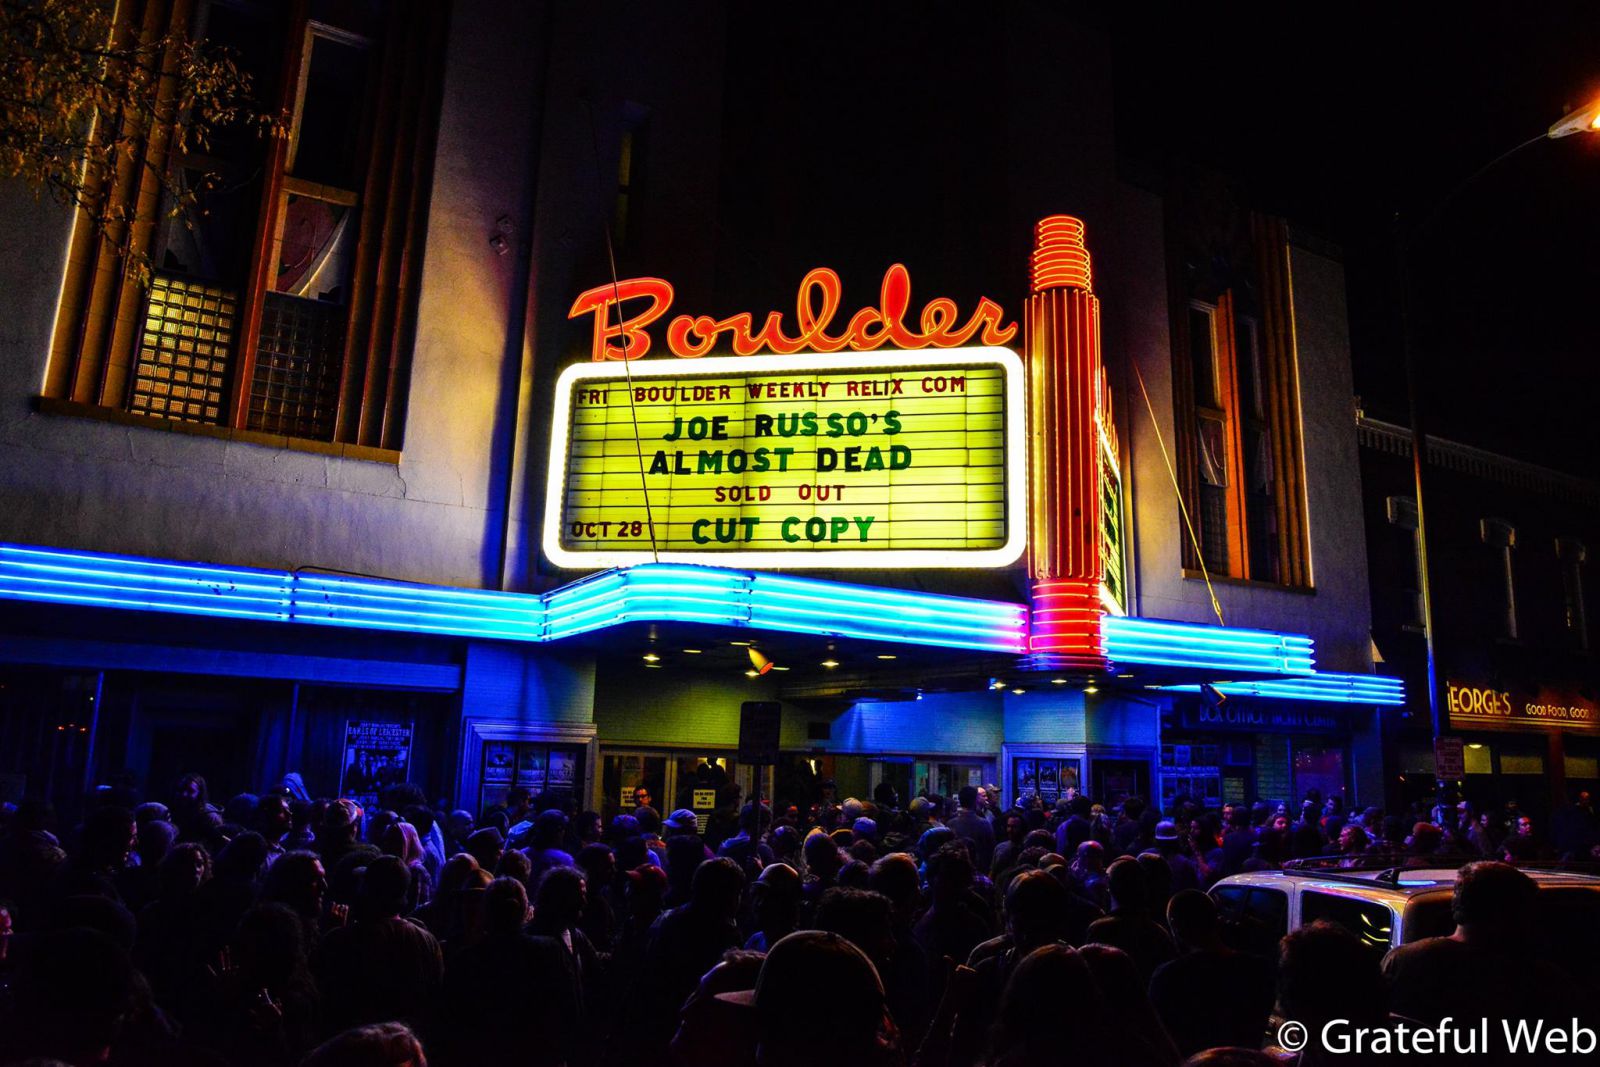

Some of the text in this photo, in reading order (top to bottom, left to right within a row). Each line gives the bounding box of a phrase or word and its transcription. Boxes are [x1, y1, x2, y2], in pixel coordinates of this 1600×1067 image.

[568, 263, 1018, 362] Boulder
[577, 376, 966, 405] FRI BOULDER WEEKLY RELIX COM
[663, 410, 902, 441] JOE RUSSO'S
[648, 444, 912, 475] ALMOST DEAD
[714, 484, 846, 502] SOLD OUT
[571, 516, 875, 544] OCT 28 CUT COPY
[1447, 681, 1511, 715] EORGE'S
[1525, 703, 1546, 715] GOOD
